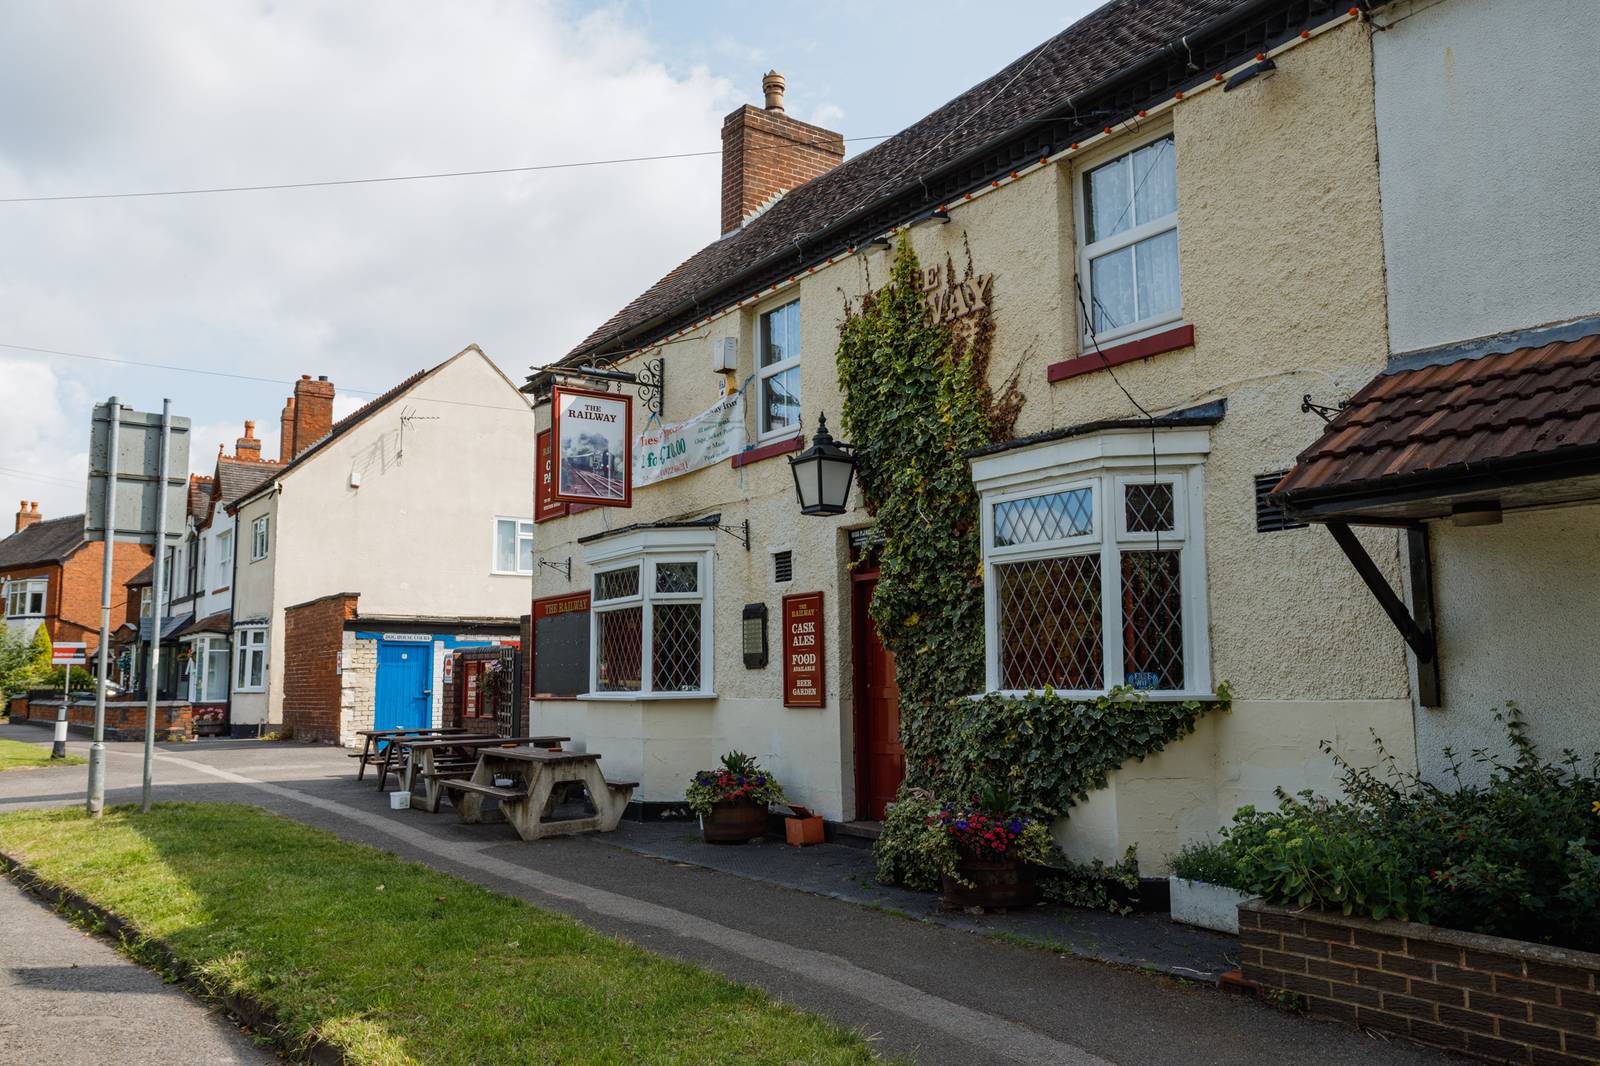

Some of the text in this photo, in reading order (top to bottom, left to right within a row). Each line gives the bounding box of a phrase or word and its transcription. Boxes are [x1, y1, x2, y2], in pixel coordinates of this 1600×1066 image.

[585, 404, 602, 412] THE
[567, 409, 617, 423] RAILWAY
[545, 599, 588, 615] THE RAILWAY
[791, 609, 815, 617] RAILWAY
[792, 622, 815, 634] CASK
[792, 635, 815, 647] ALES
[792, 654, 816, 665] FOOD
[796, 679, 812, 687] BEER
[792, 688, 817, 696] GARDEN
